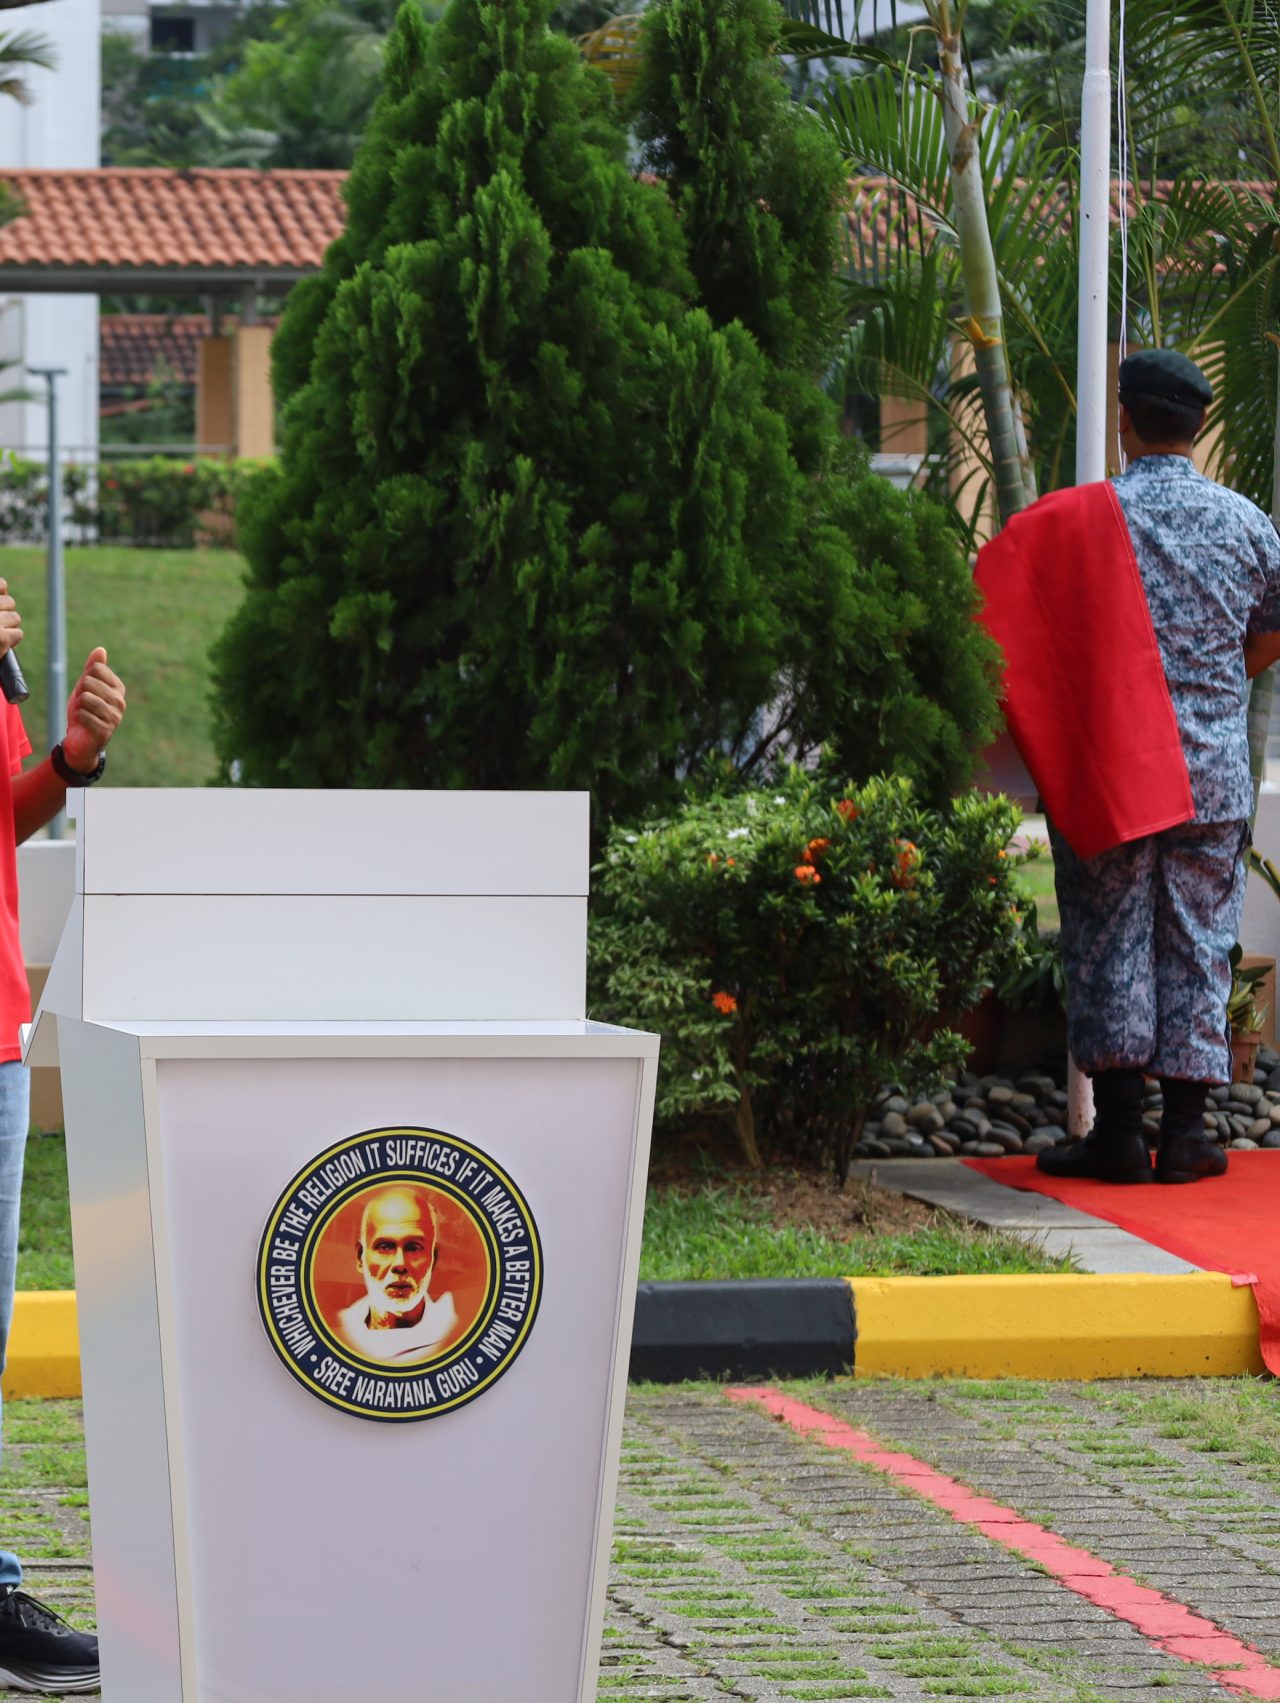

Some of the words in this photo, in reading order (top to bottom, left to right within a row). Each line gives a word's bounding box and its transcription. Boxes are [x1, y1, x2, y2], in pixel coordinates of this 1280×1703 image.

[366, 1142, 381, 1170] IT
[386, 1139, 460, 1175] SUFFICES
[455, 1158, 478, 1183] IF
[298, 1149, 367, 1210] RELIGION
[469, 1170, 494, 1195] IT
[280, 1202, 312, 1236] THE
[481, 1186, 525, 1243] MAKES
[274, 1237, 300, 1262] BE
[504, 1245, 522, 1258] A
[498, 1260, 531, 1322] BETTER
[271, 1265, 316, 1359] WHICHEVER
[478, 1319, 516, 1362] MAN
[313, 1356, 356, 1397] SREE
[352, 1375, 437, 1408] NARAYANA
[437, 1357, 479, 1399] GURU
